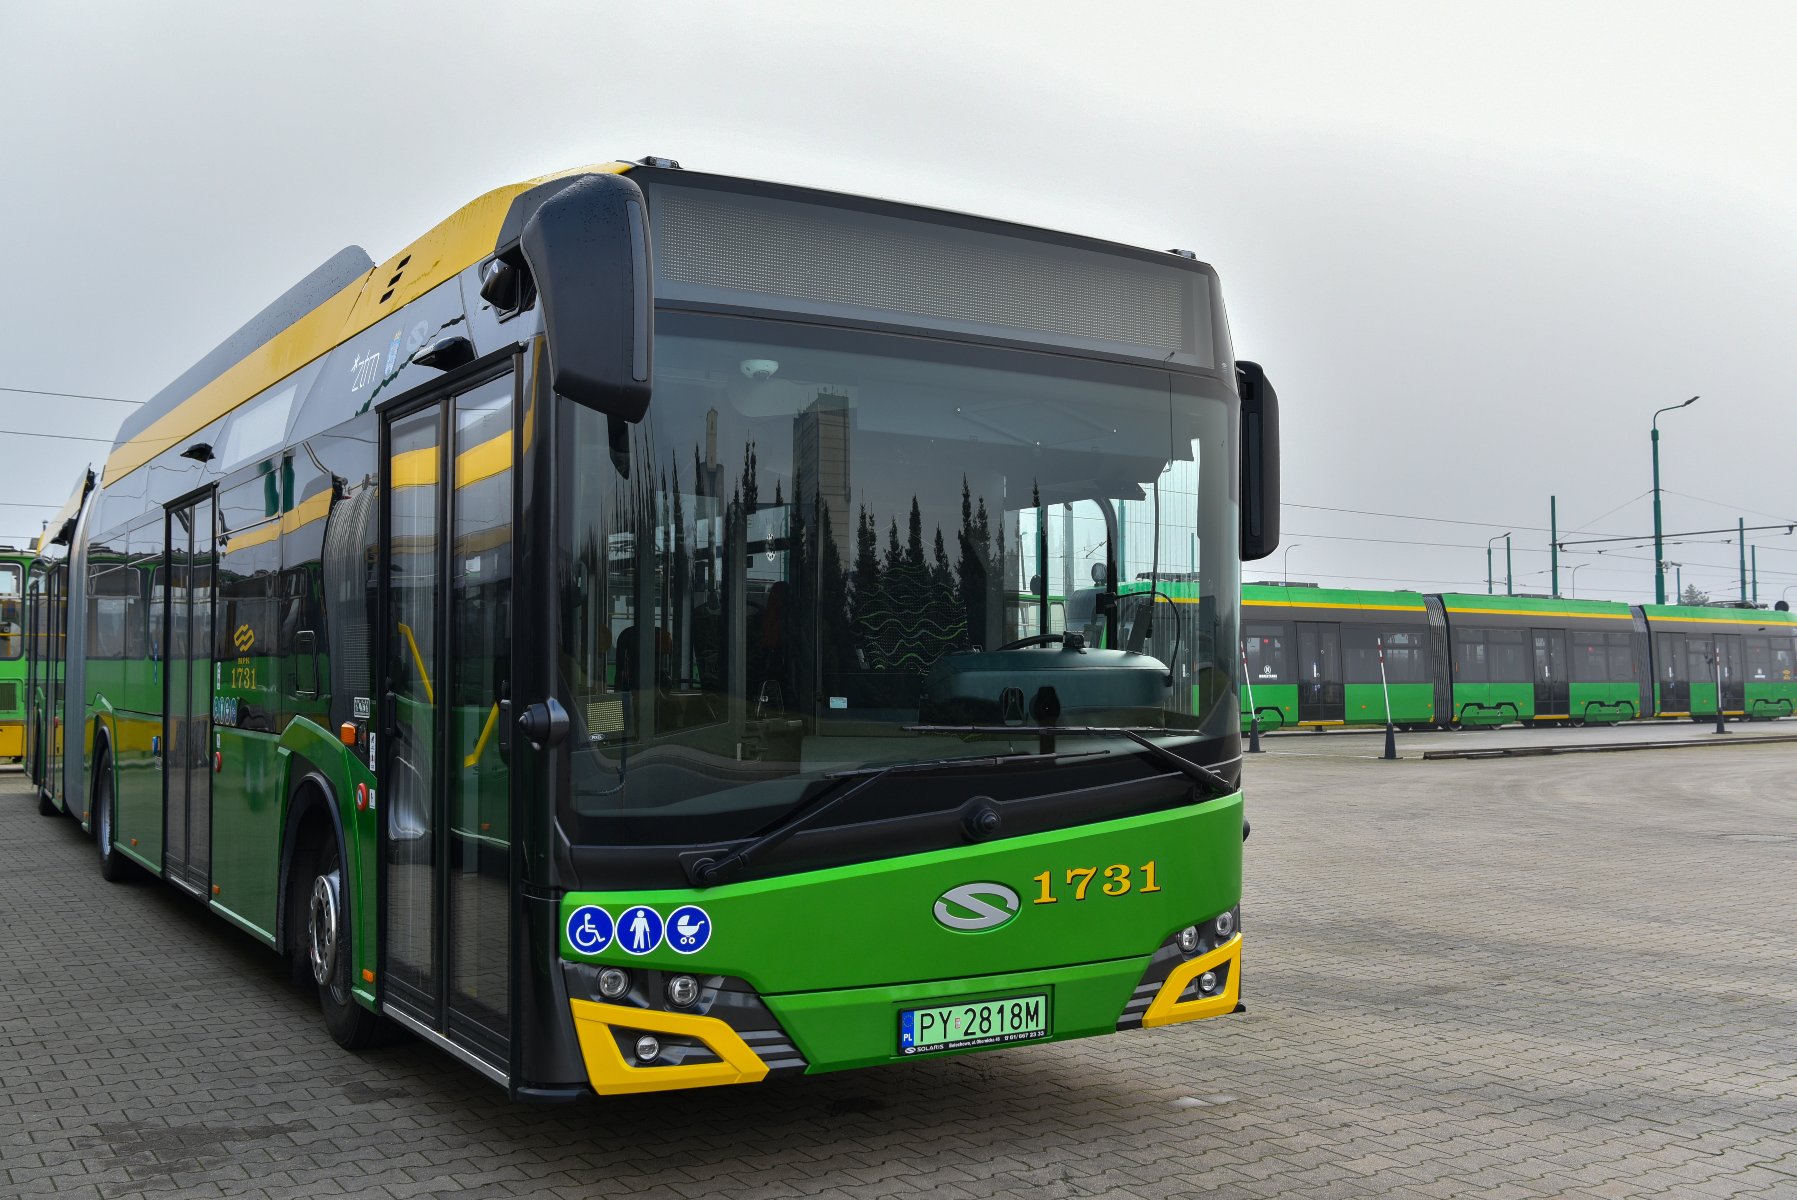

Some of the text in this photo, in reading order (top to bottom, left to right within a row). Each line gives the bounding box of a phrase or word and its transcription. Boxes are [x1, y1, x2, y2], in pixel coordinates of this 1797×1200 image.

[231, 667, 257, 690] 1731
[1033, 860, 1161, 905] 1731
[920, 1000, 1040, 1042] PY 2818M
[903, 1033, 913, 1042] PL
[916, 1044, 944, 1053] SOLARIS
